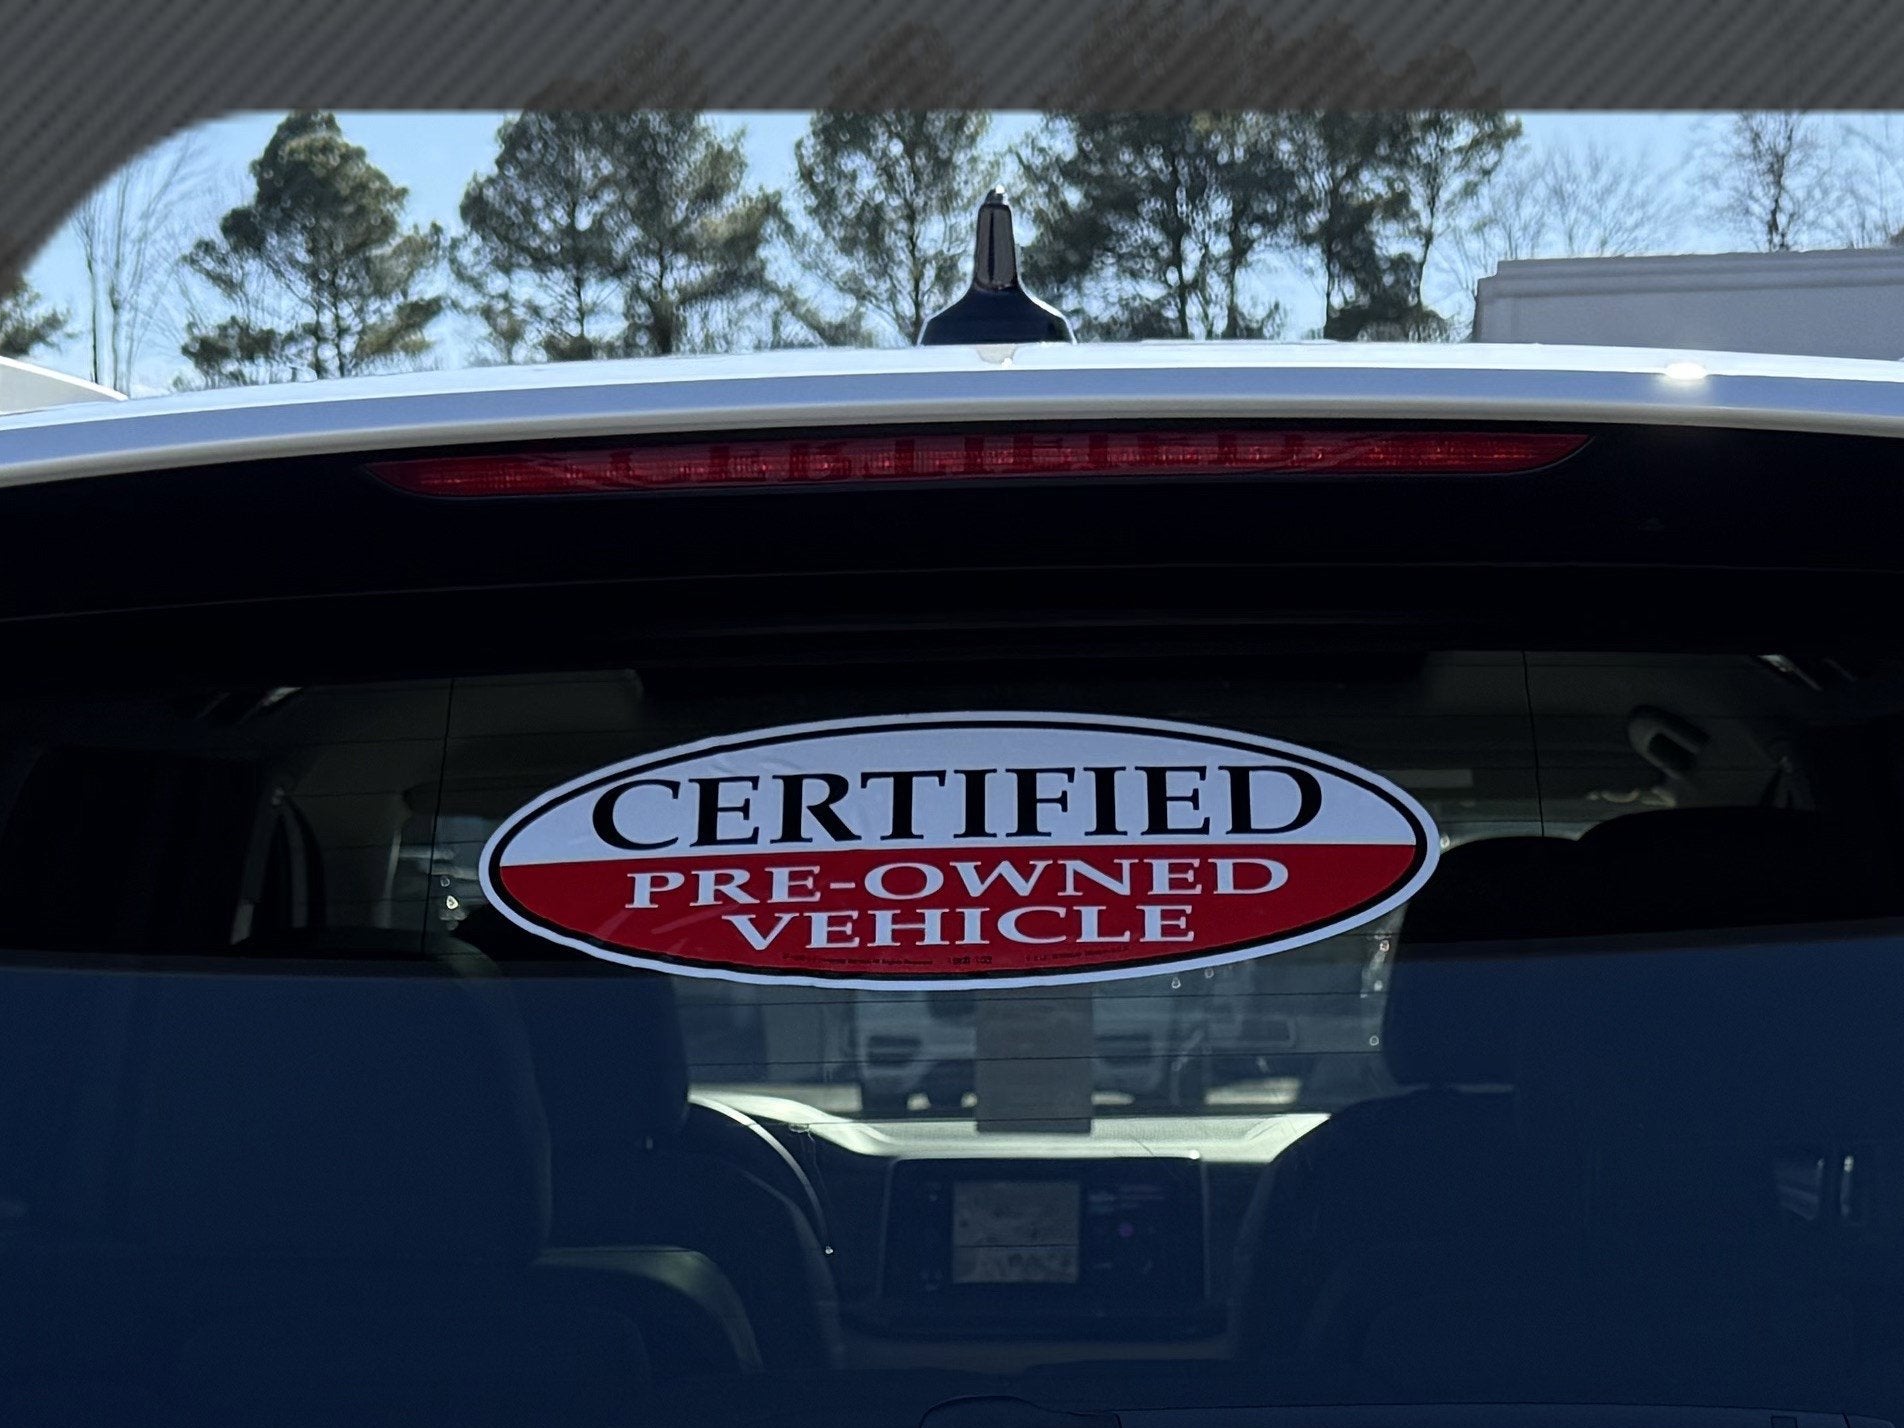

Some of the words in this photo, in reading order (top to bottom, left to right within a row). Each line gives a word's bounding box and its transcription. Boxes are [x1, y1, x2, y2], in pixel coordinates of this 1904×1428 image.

[591, 763, 1322, 852] CERTIFIED
[625, 857, 1289, 910] PRE-OWNED
[722, 903, 1195, 951] VEHICLE
